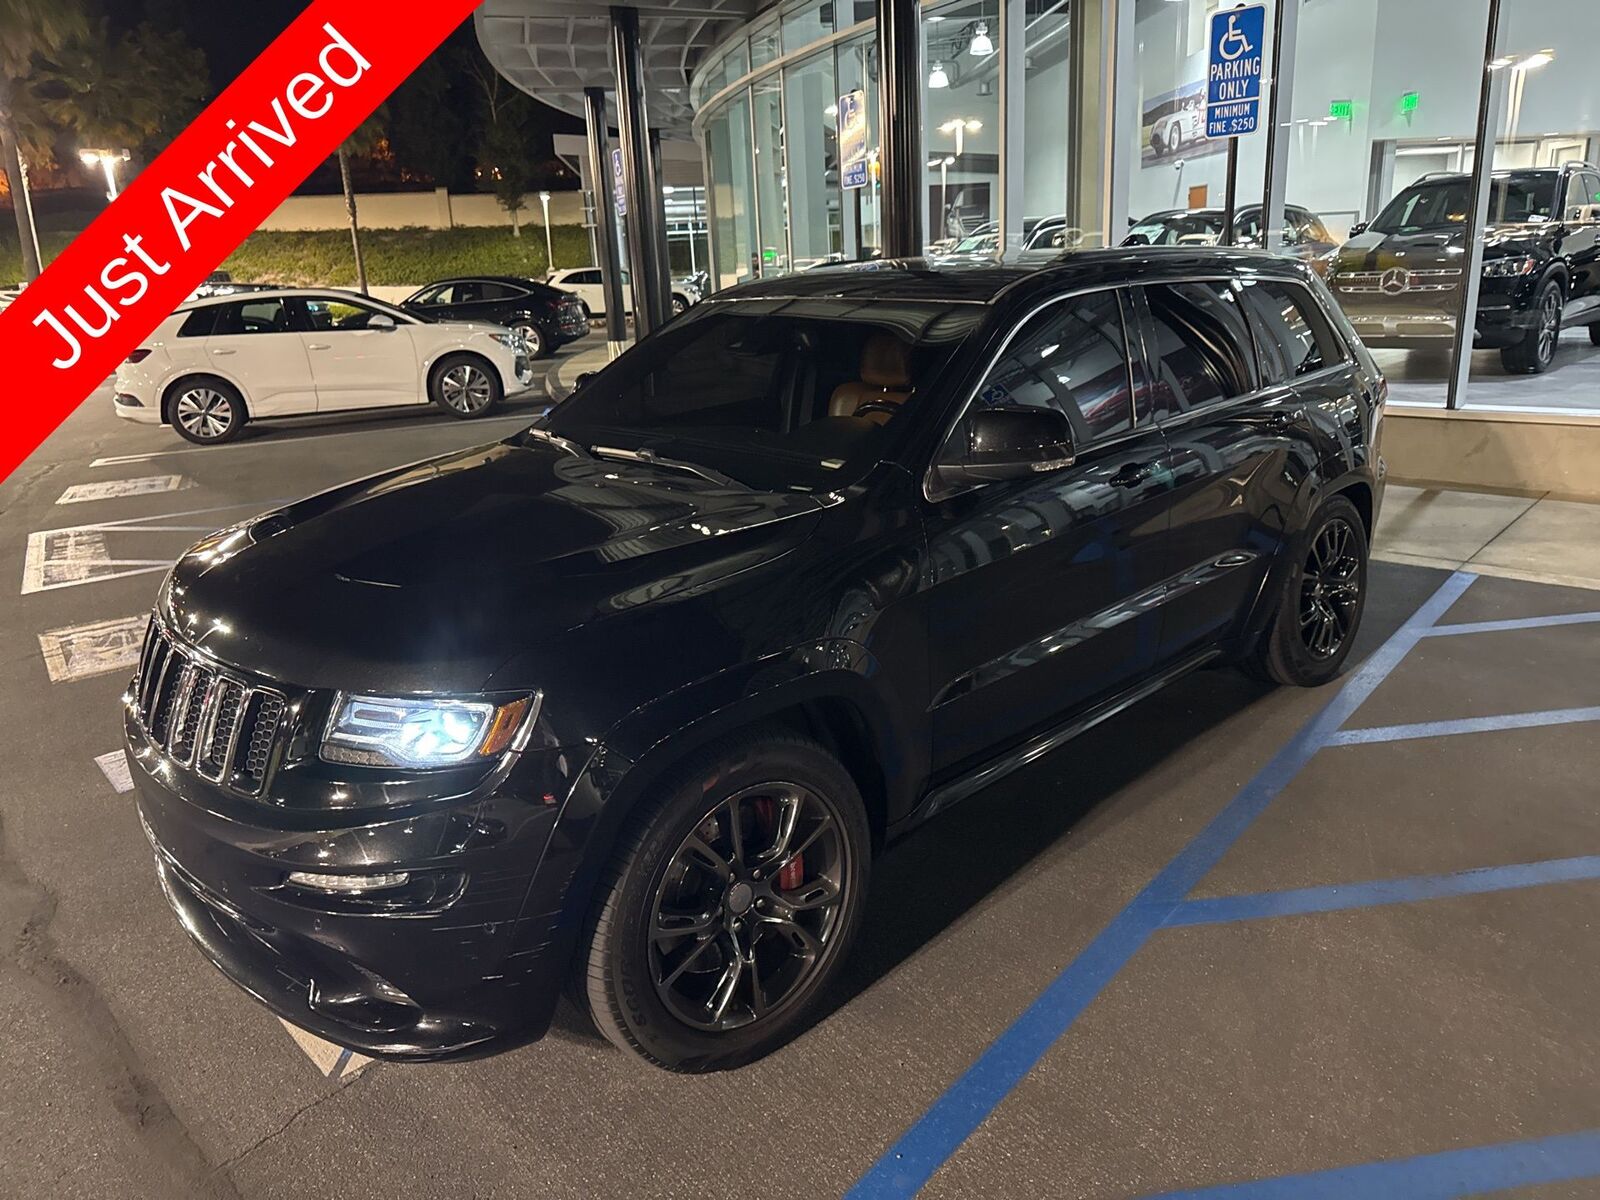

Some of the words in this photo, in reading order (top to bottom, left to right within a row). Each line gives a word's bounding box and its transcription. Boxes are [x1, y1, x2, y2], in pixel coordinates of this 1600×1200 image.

[1210, 57, 1260, 81] PARKING
[1219, 79, 1249, 100] ONLY
[1215, 103, 1250, 119] MINIMUM
[1209, 121, 1227, 135] FINE
[1231, 117, 1254, 132] $250
